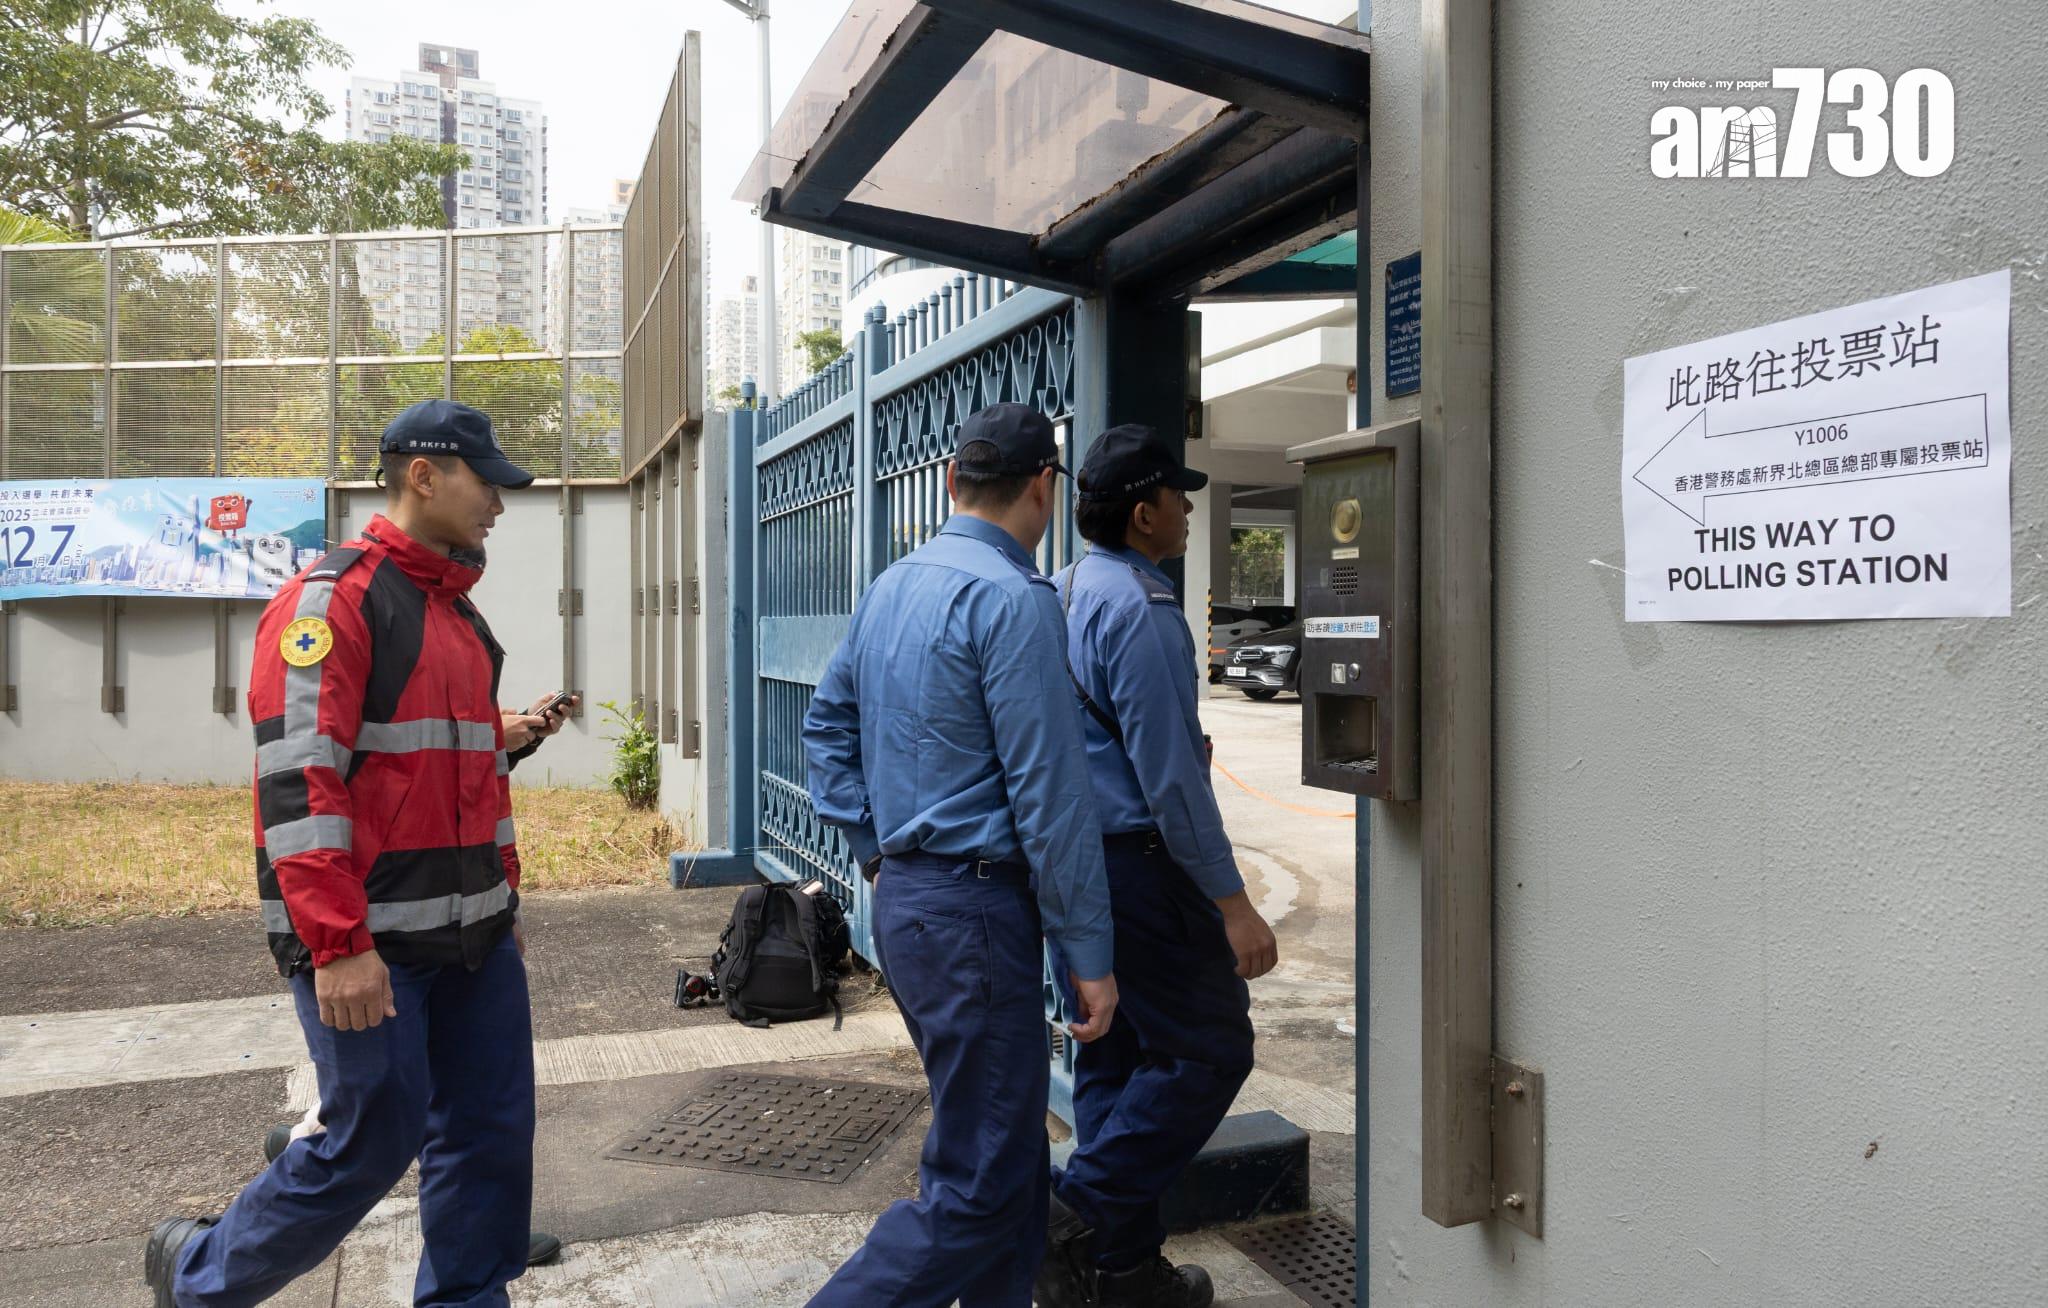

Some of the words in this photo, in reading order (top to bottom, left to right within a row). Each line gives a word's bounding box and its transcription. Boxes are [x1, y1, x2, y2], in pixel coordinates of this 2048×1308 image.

[1665, 314, 1942, 412] 此路往投票站
[420, 441, 447, 449] HKFS
[1795, 423, 1849, 446] Y1006
[1674, 439, 1985, 493] 香港警務處新界北總區總部專屬投票站
[0, 509, 31, 522] 2025
[1694, 525, 1756, 554] THIS
[1765, 518, 1840, 548] WAY
[1849, 513, 1896, 544] TO
[1667, 561, 1786, 592] POLLING
[1796, 553, 1949, 587] STATION
